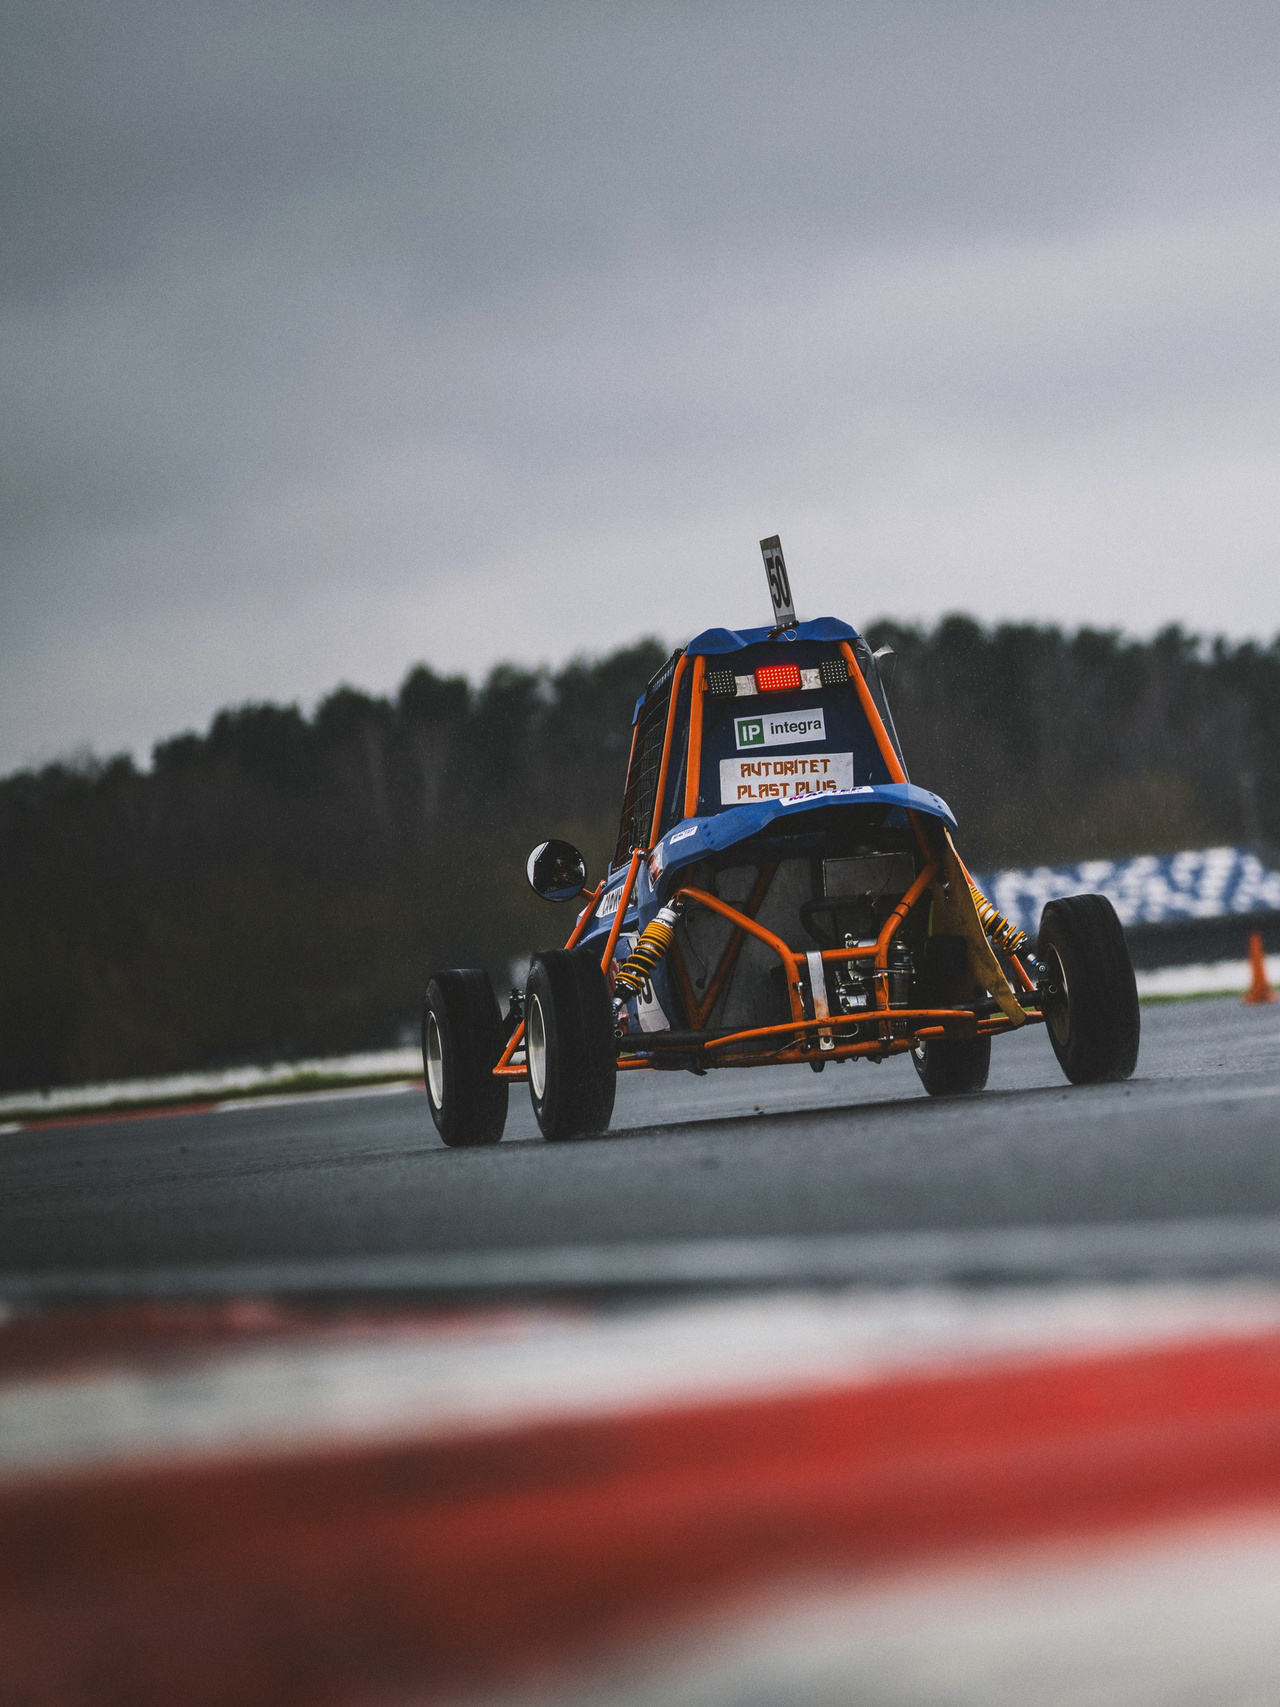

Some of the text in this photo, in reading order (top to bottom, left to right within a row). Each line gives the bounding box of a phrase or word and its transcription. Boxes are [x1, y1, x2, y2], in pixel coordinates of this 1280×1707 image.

[765, 555, 791, 609] 50
[741, 719, 822, 742] IP integra
[736, 782, 790, 800] PLAST
